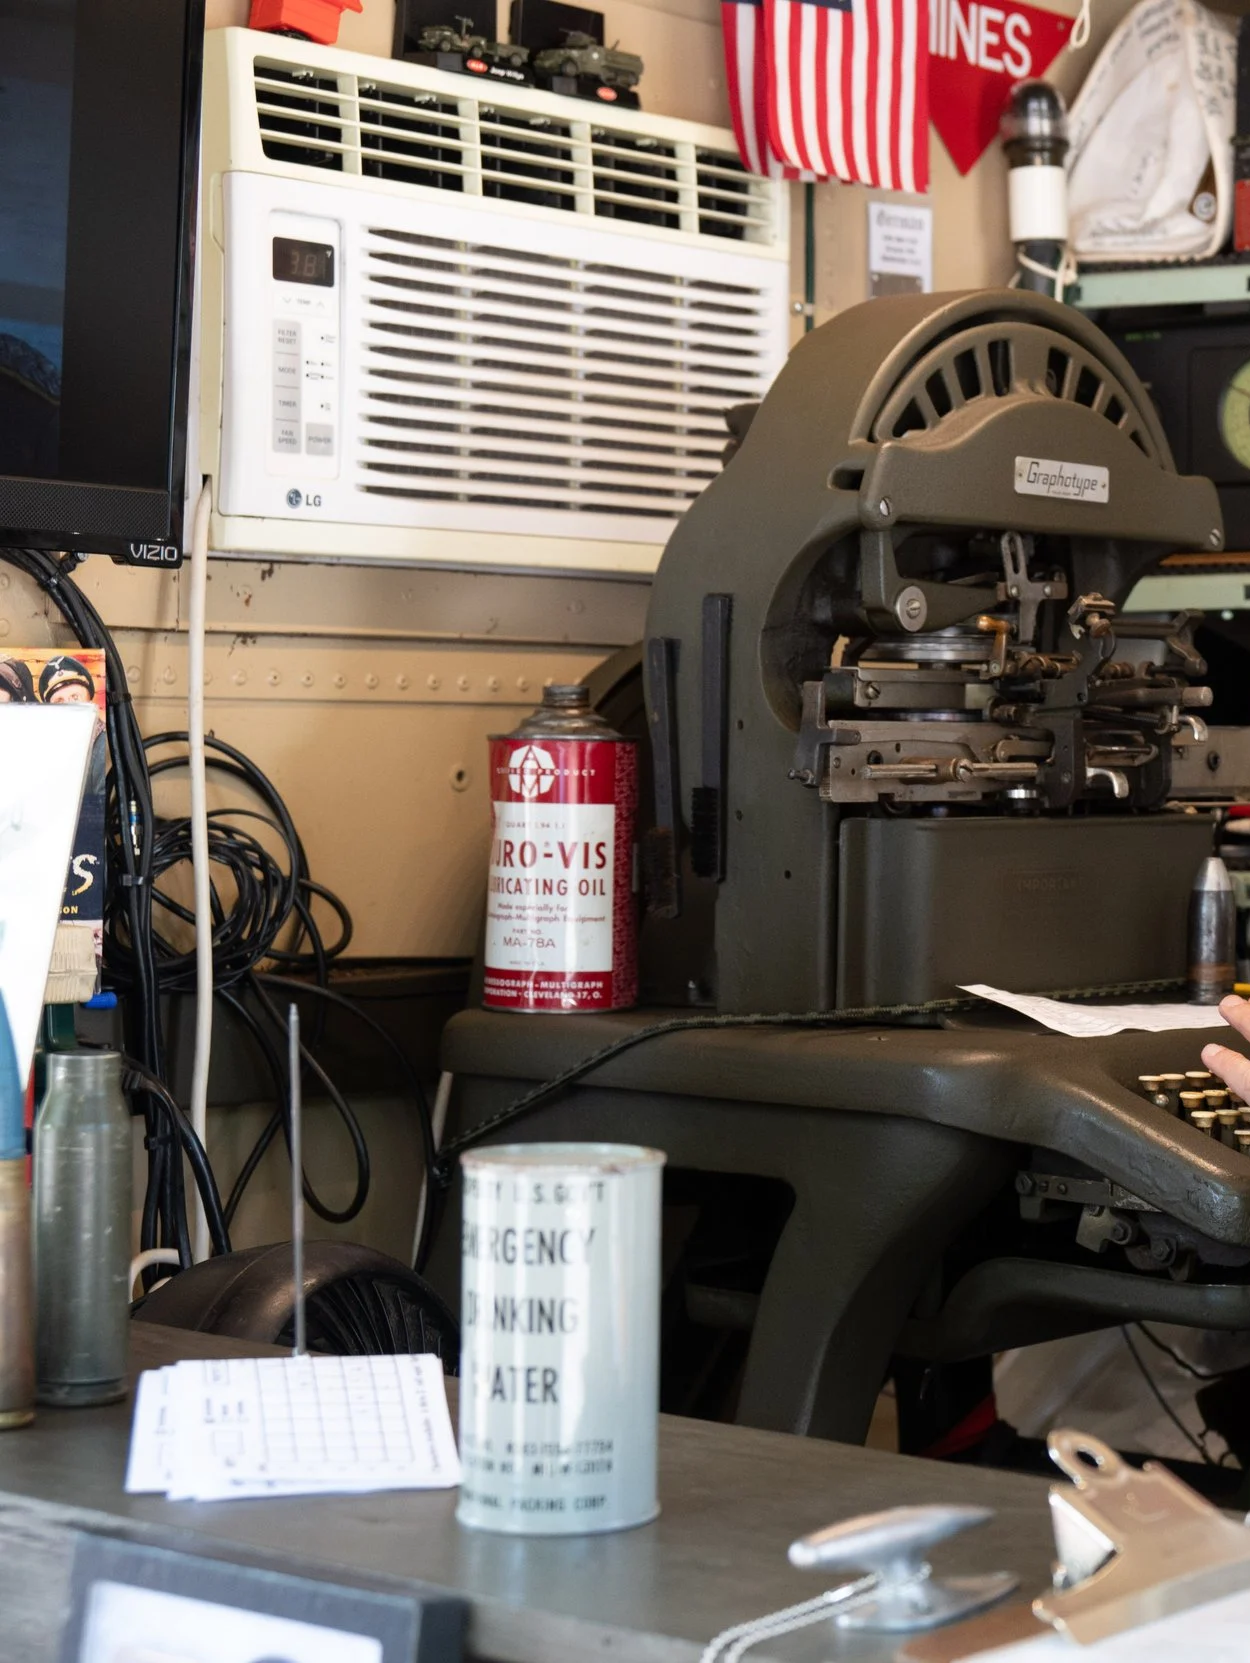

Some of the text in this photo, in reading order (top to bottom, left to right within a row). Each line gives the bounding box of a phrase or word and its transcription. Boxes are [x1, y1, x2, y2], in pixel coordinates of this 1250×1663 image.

[278, 367, 296, 375] MODE
[308, 436, 332, 444] POWER
[1026, 461, 1098, 497] Graphotype
[306, 494, 322, 507] LG
[131, 543, 177, 562] VIZIO
[537, 768, 596, 777] PRODUCT
[578, 879, 606, 896] OIL
[503, 937, 556, 949] MA-78A
[540, 981, 604, 990] MULTIGRAPH
